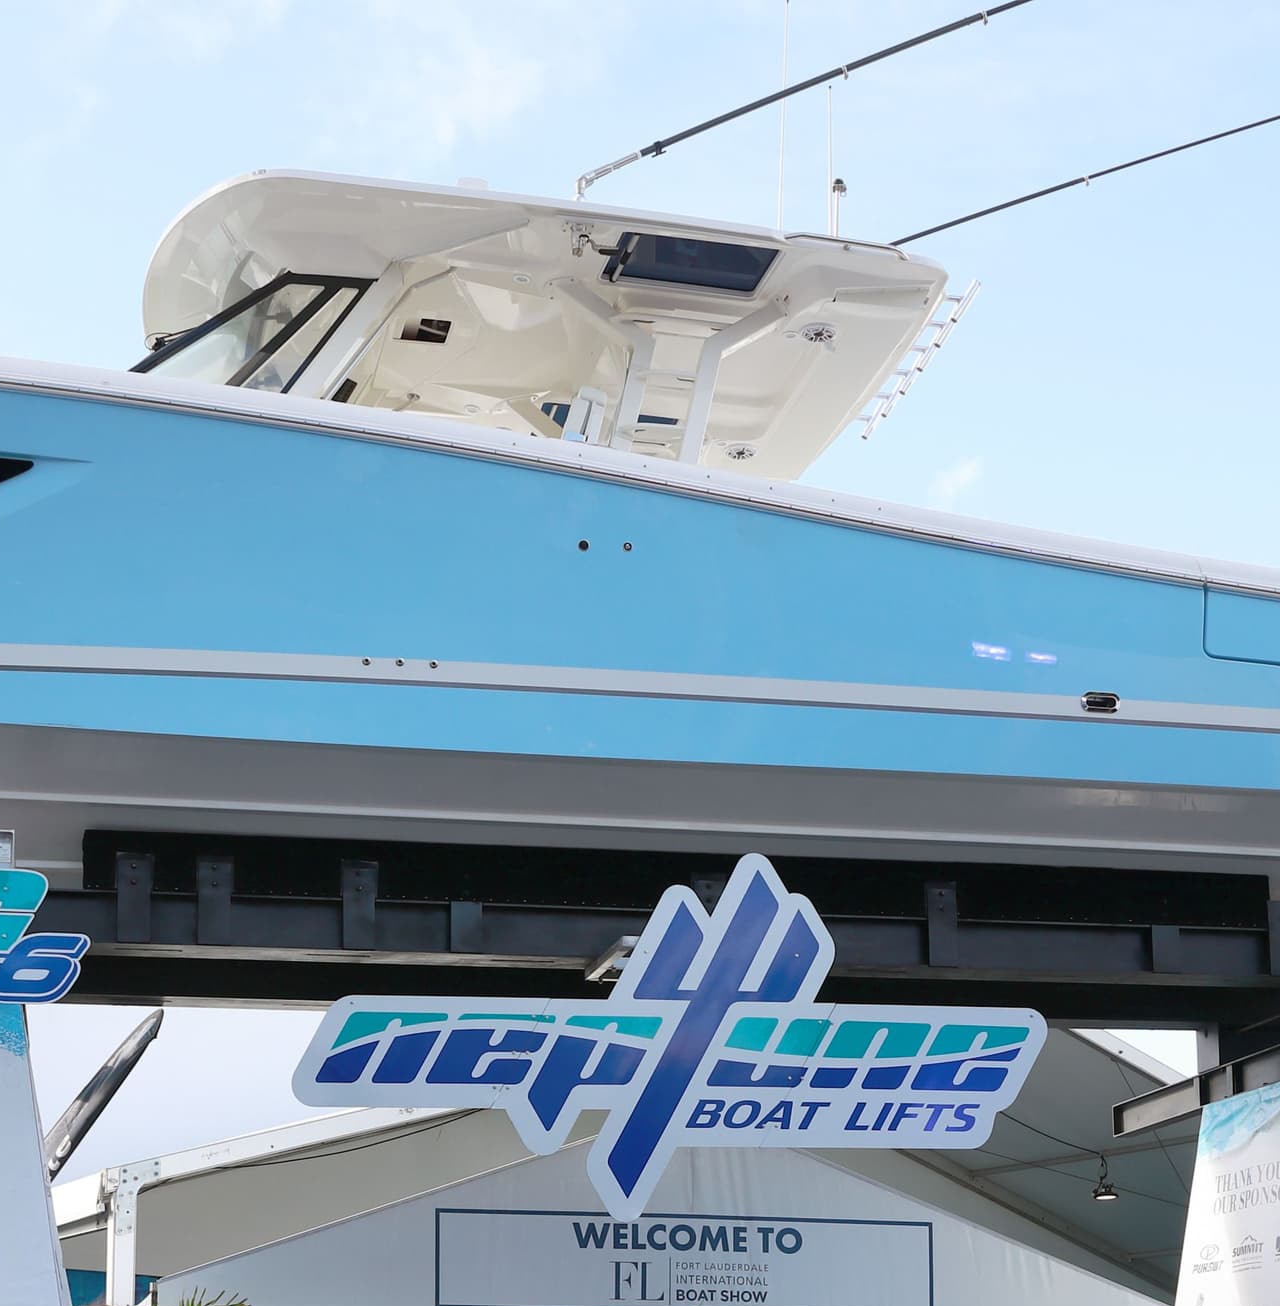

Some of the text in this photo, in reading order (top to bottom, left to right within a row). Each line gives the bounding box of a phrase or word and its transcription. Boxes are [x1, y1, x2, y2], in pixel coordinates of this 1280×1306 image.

[686, 1098, 981, 1133] BOAT LIFTS
[1216, 1167, 1253, 1194] THANK
[1213, 1193, 1237, 1215] OUR
[572, 1222, 803, 1254] WELCOME TO
[1232, 1242, 1264, 1258] SUMMIT
[675, 1261, 769, 1272] FORT LAUDERDALE
[609, 1260, 665, 1301] FL
[676, 1275, 769, 1287] INTERNATIONAL
[676, 1289, 768, 1303] BOAT SHOW
